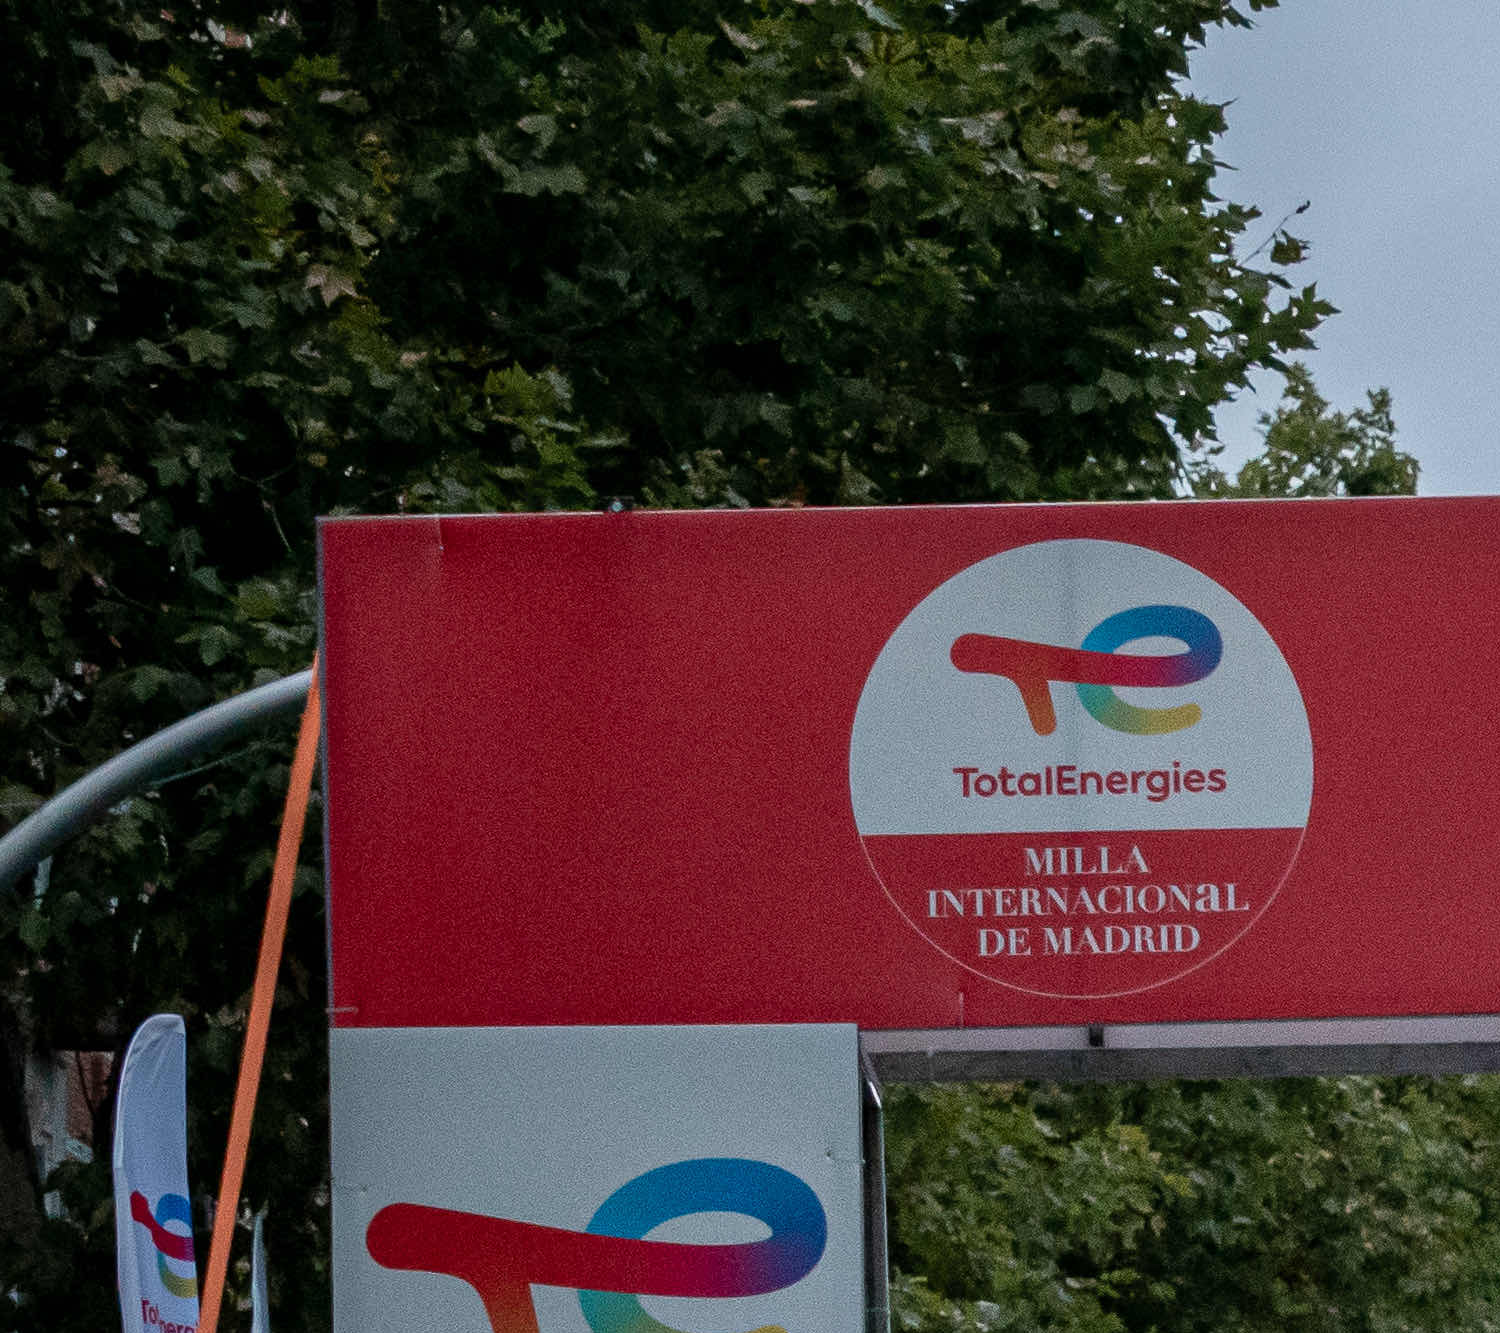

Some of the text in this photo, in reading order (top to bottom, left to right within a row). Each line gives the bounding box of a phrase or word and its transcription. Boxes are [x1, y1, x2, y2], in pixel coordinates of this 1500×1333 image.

[953, 764, 1227, 803] TotalEnergies
[1025, 846, 1151, 876] MILLA
[978, 922, 1201, 957] DE MADRID
